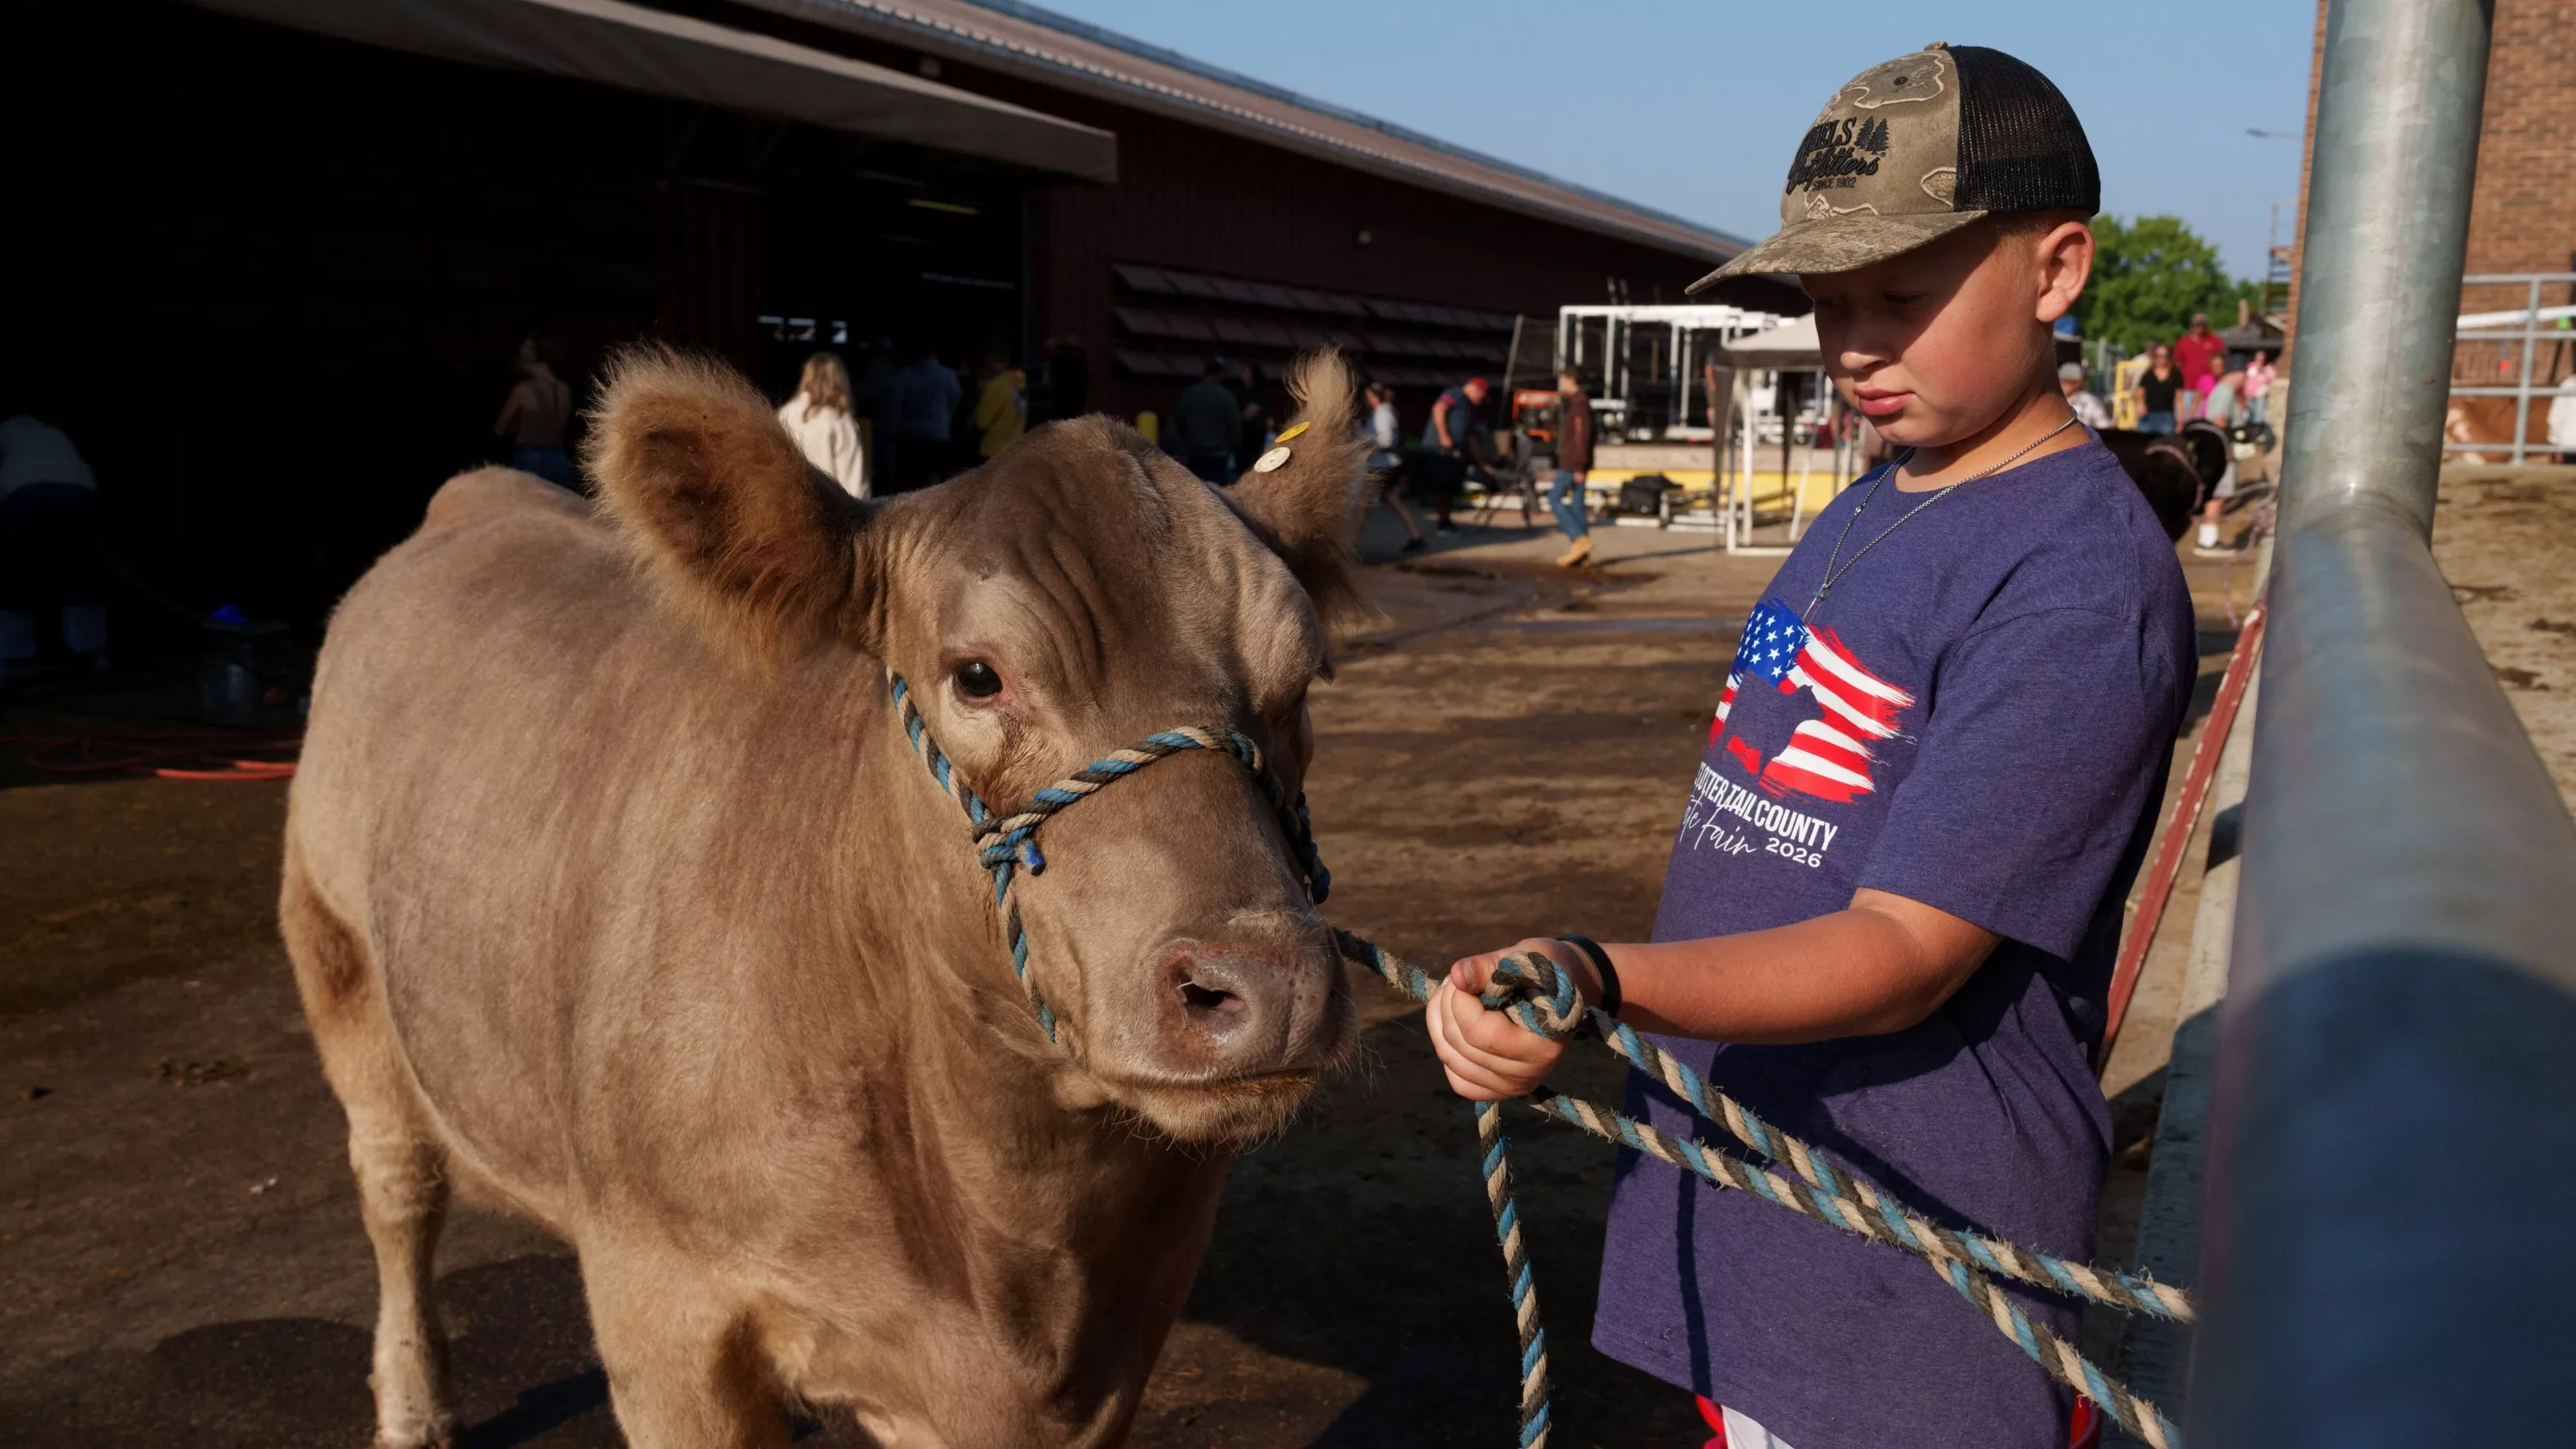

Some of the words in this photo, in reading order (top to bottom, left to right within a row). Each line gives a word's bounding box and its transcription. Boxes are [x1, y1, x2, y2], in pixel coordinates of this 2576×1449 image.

[1694, 805, 1757, 856] Fair
[1765, 837, 1823, 868] 2026
[1696, 765, 1730, 808] OTTER
[1724, 782, 1757, 822] TAIL
[1754, 800, 1838, 851] COUNTY
